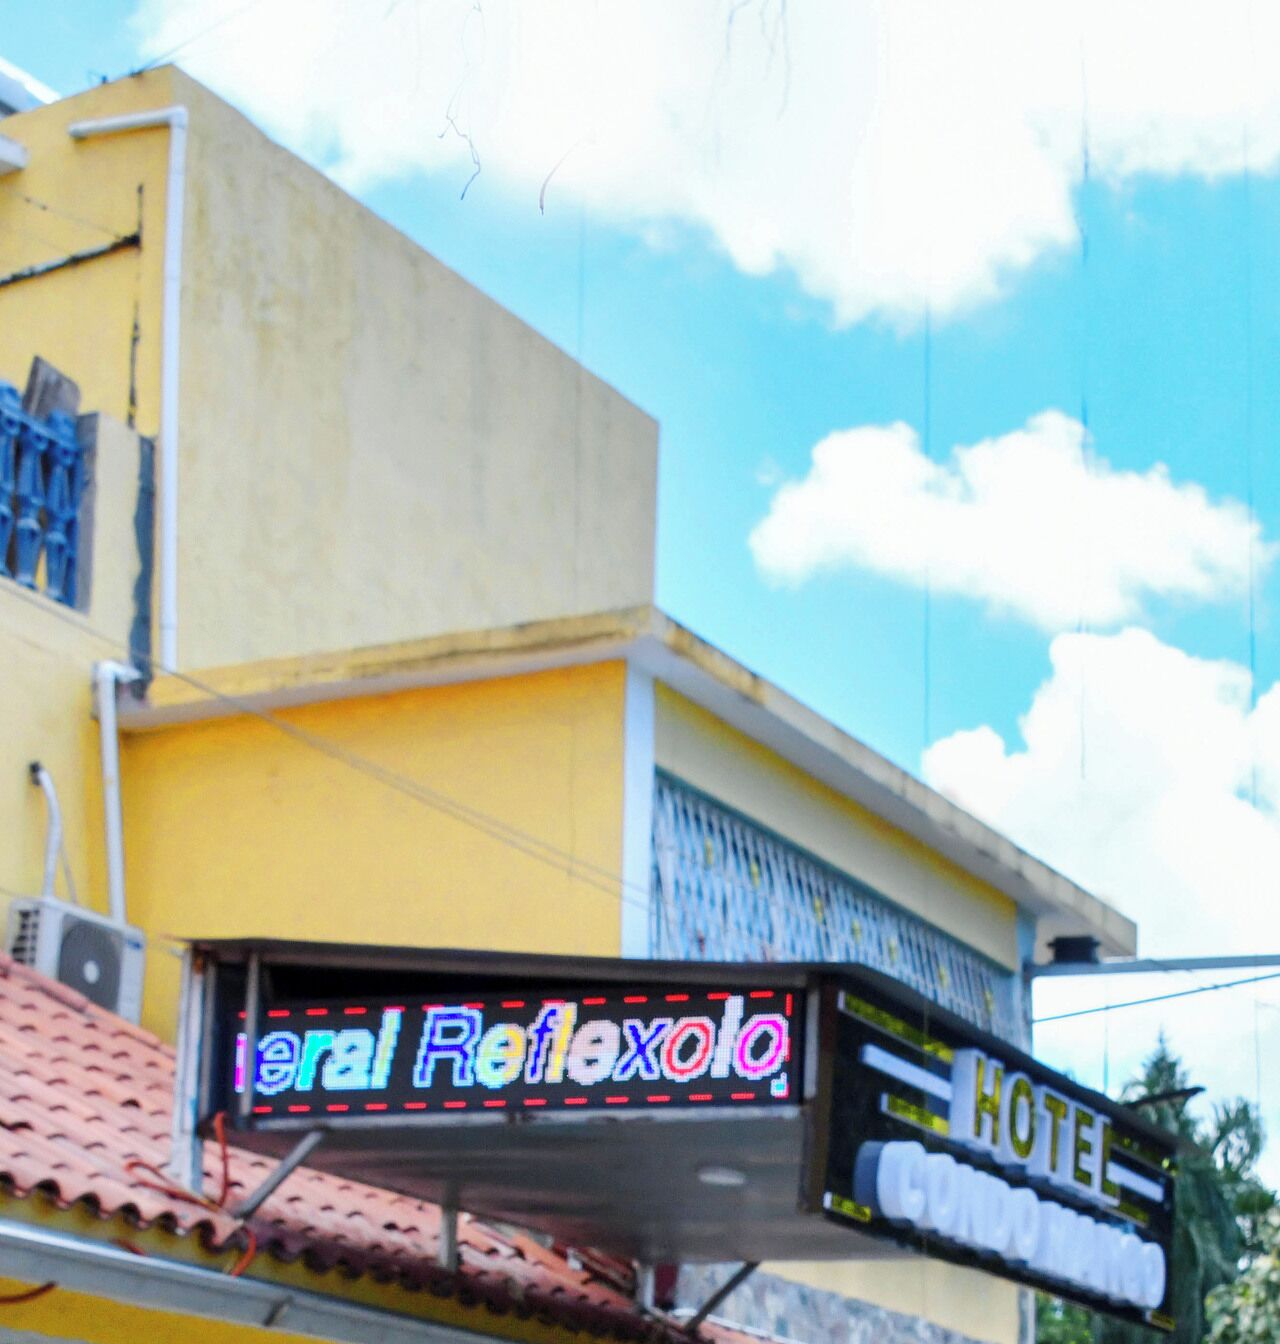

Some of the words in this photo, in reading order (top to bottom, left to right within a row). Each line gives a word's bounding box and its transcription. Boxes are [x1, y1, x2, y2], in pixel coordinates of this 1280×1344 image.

[235, 1009, 402, 1096] eral
[412, 995, 790, 1097] Reflexolo
[960, 1050, 1120, 1207] HOTEL
